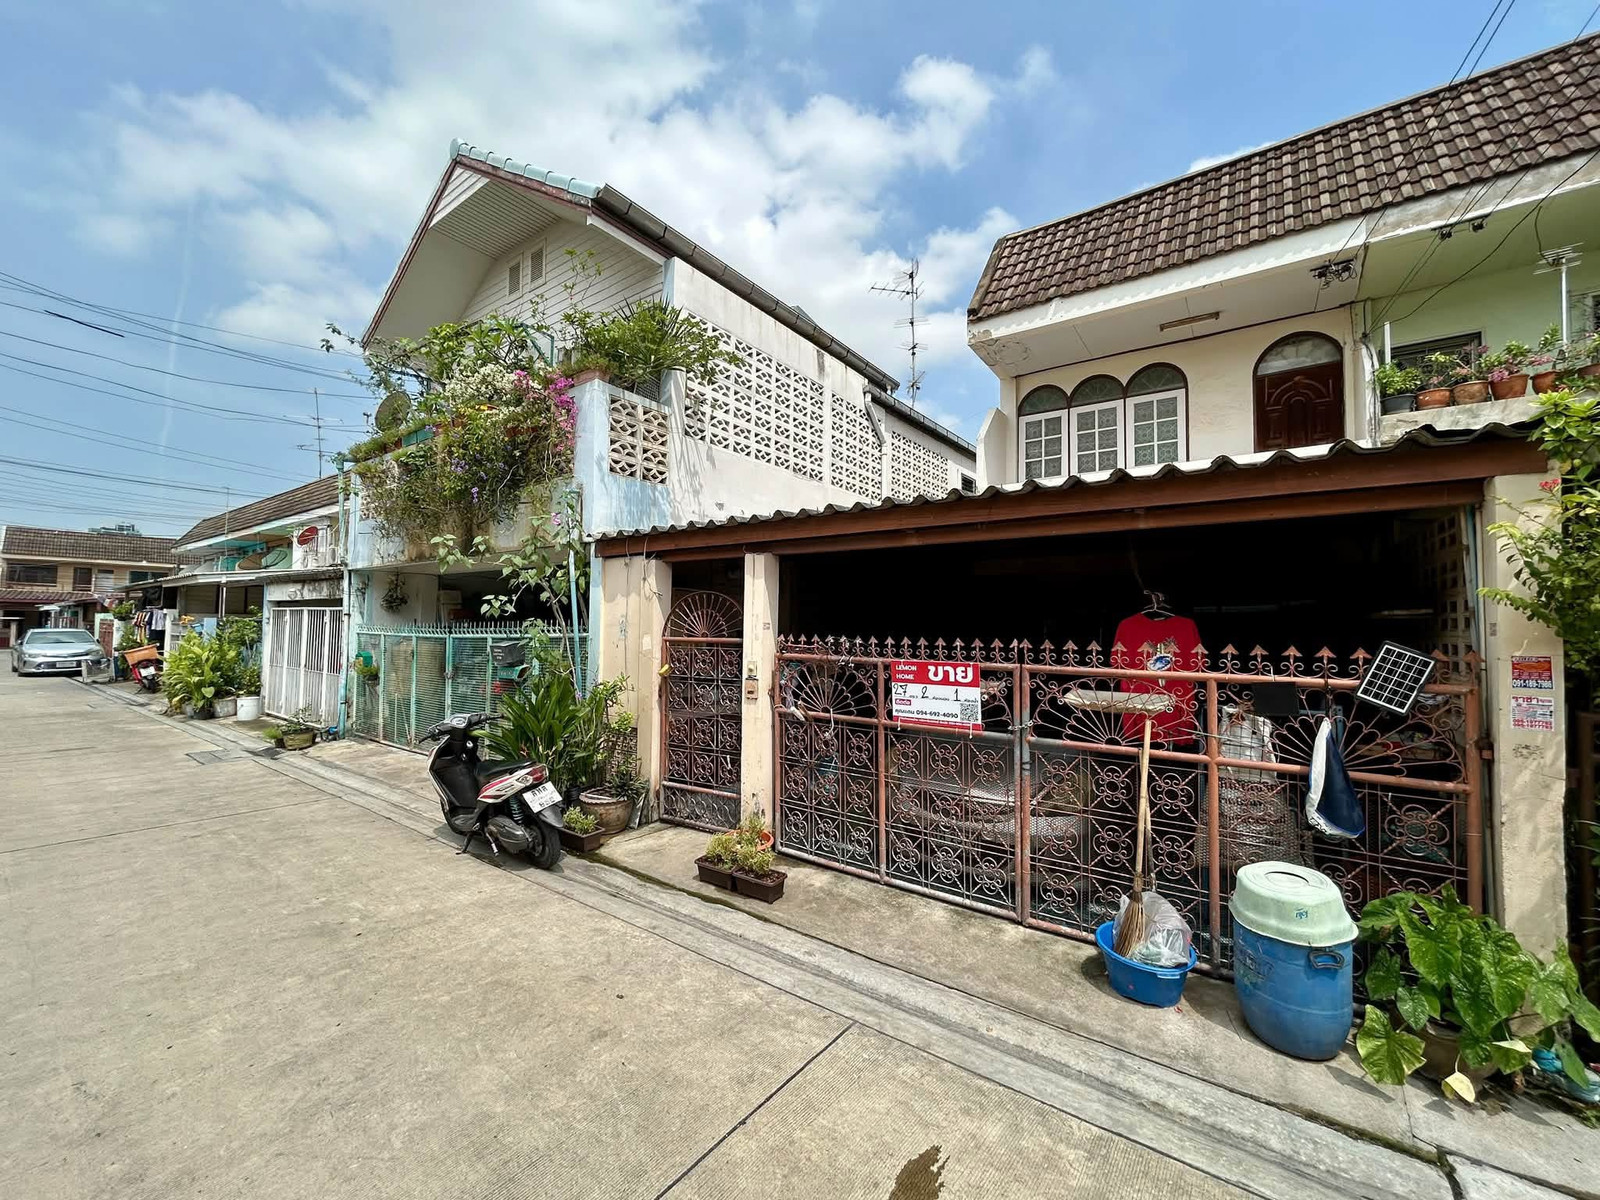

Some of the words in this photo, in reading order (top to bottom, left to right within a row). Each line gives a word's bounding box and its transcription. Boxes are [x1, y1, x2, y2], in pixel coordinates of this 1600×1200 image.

[928, 665, 973, 683] ขาย
[893, 683, 908, 696] 27
[922, 686, 928, 698] 2
[954, 688, 960, 701] 1
